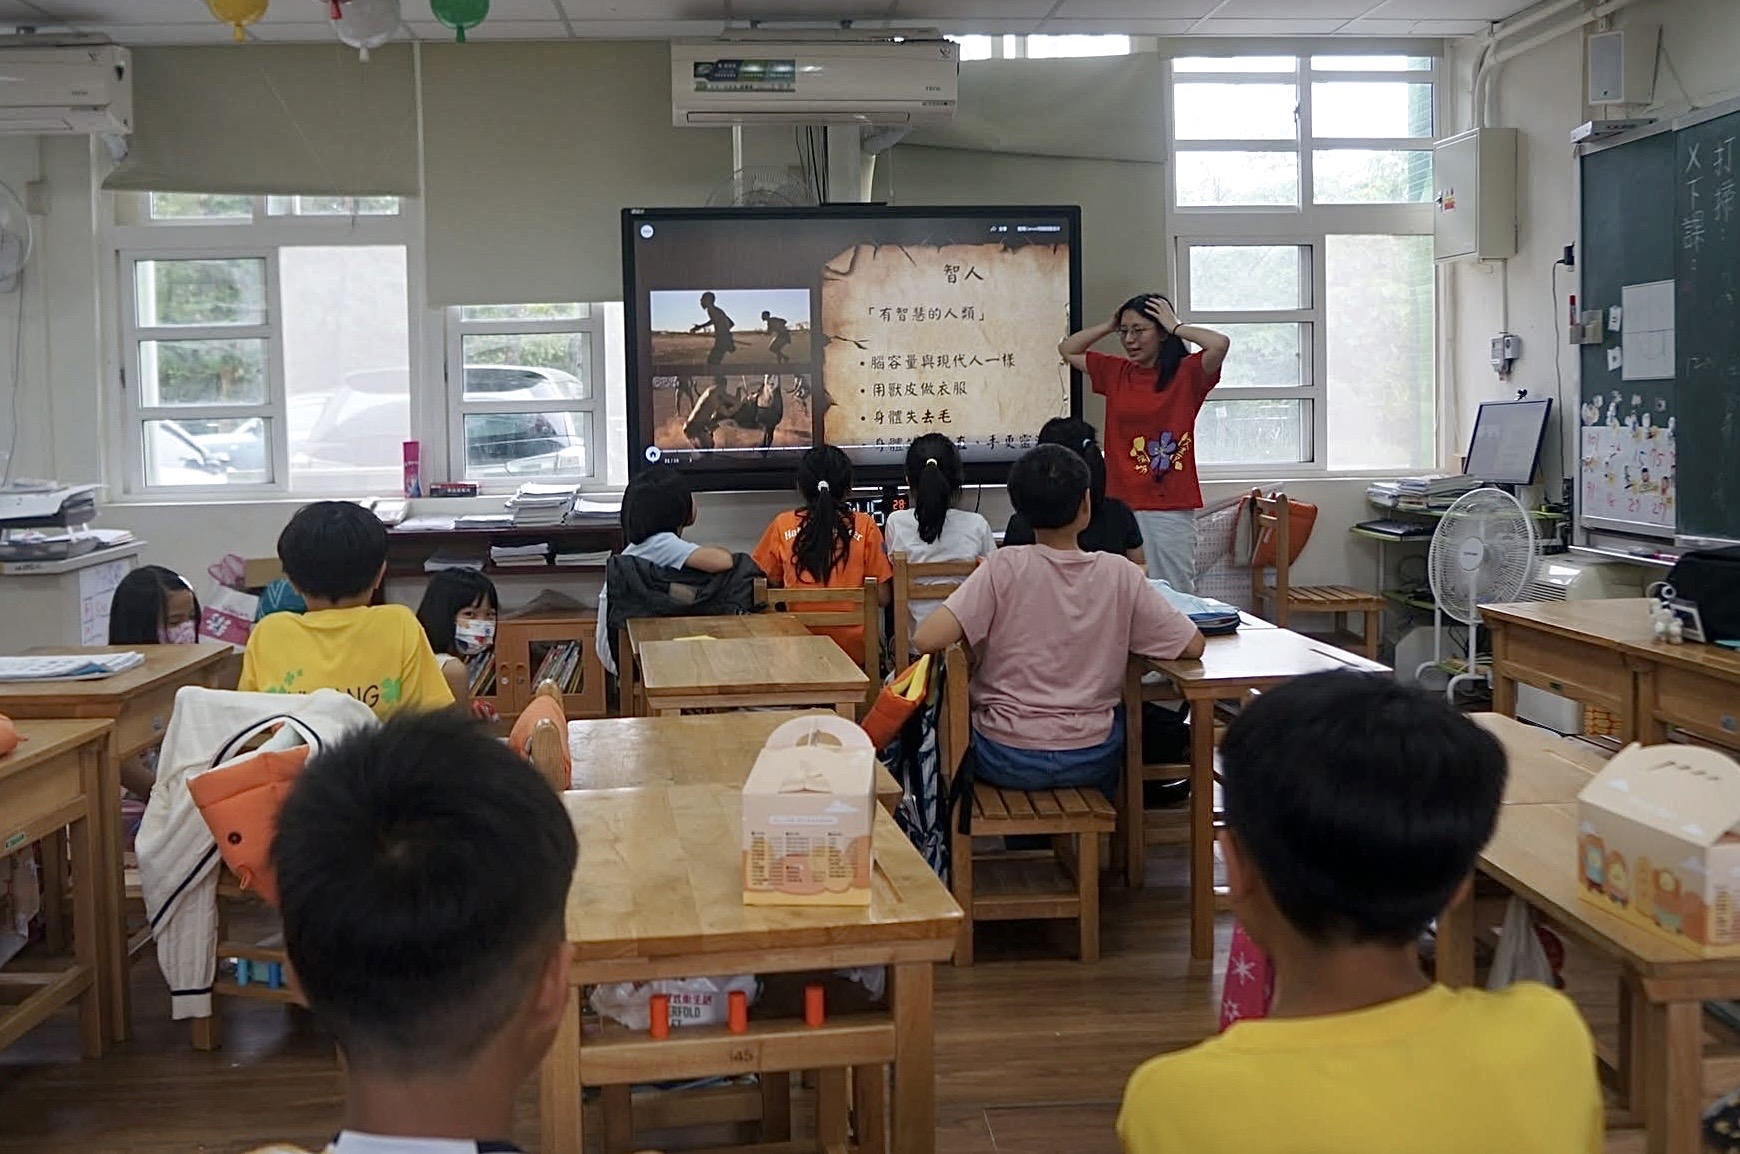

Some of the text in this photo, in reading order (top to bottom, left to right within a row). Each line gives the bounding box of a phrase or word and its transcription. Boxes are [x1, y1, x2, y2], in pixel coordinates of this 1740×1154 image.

[943, 264, 984, 284] 智人
[870, 353, 1016, 370] 腦容量與現代人一樣
[873, 381, 968, 398] 用獸皮做衣服
[873, 408, 952, 425] 身體失去毛
